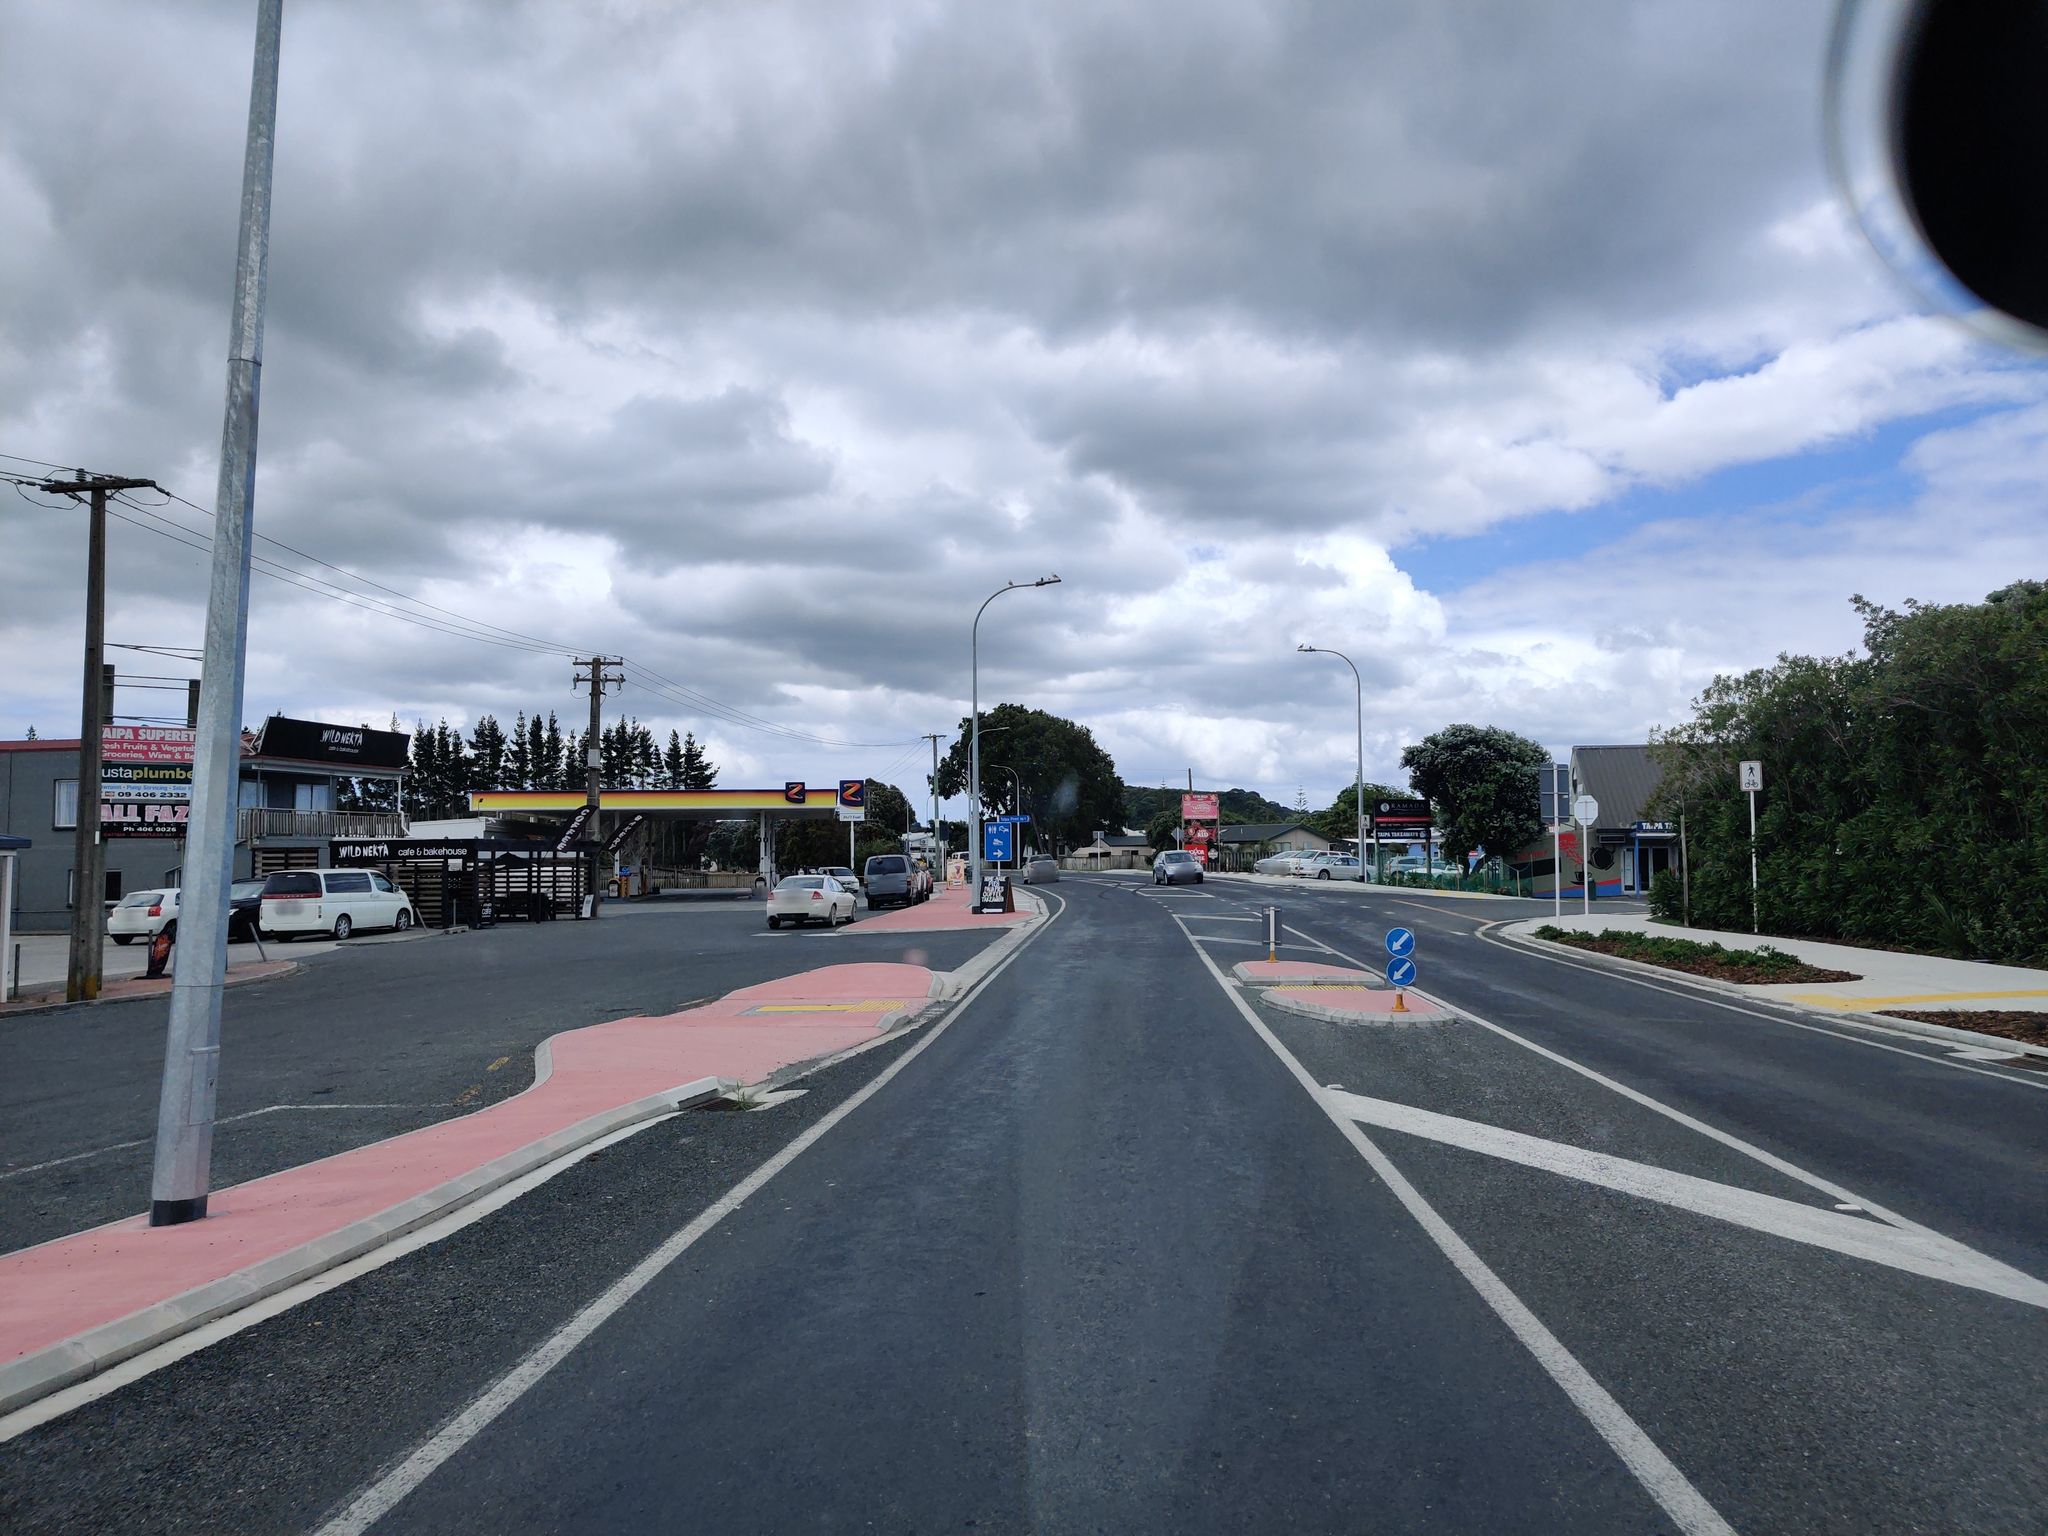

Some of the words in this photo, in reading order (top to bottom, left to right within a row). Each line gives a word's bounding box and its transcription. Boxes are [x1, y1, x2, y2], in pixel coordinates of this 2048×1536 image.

[102, 728, 134, 739] AIPA
[321, 729, 341, 743] WILD
[102, 767, 193, 780] ustaplumbe
[556, 808, 590, 851] COFFEE
[608, 814, 643, 850] BAKERY
[339, 845, 361, 858] WILD
[398, 848, 414, 856] cafe
[416, 848, 422, 856] &
[423, 847, 467, 856] bakehouse
